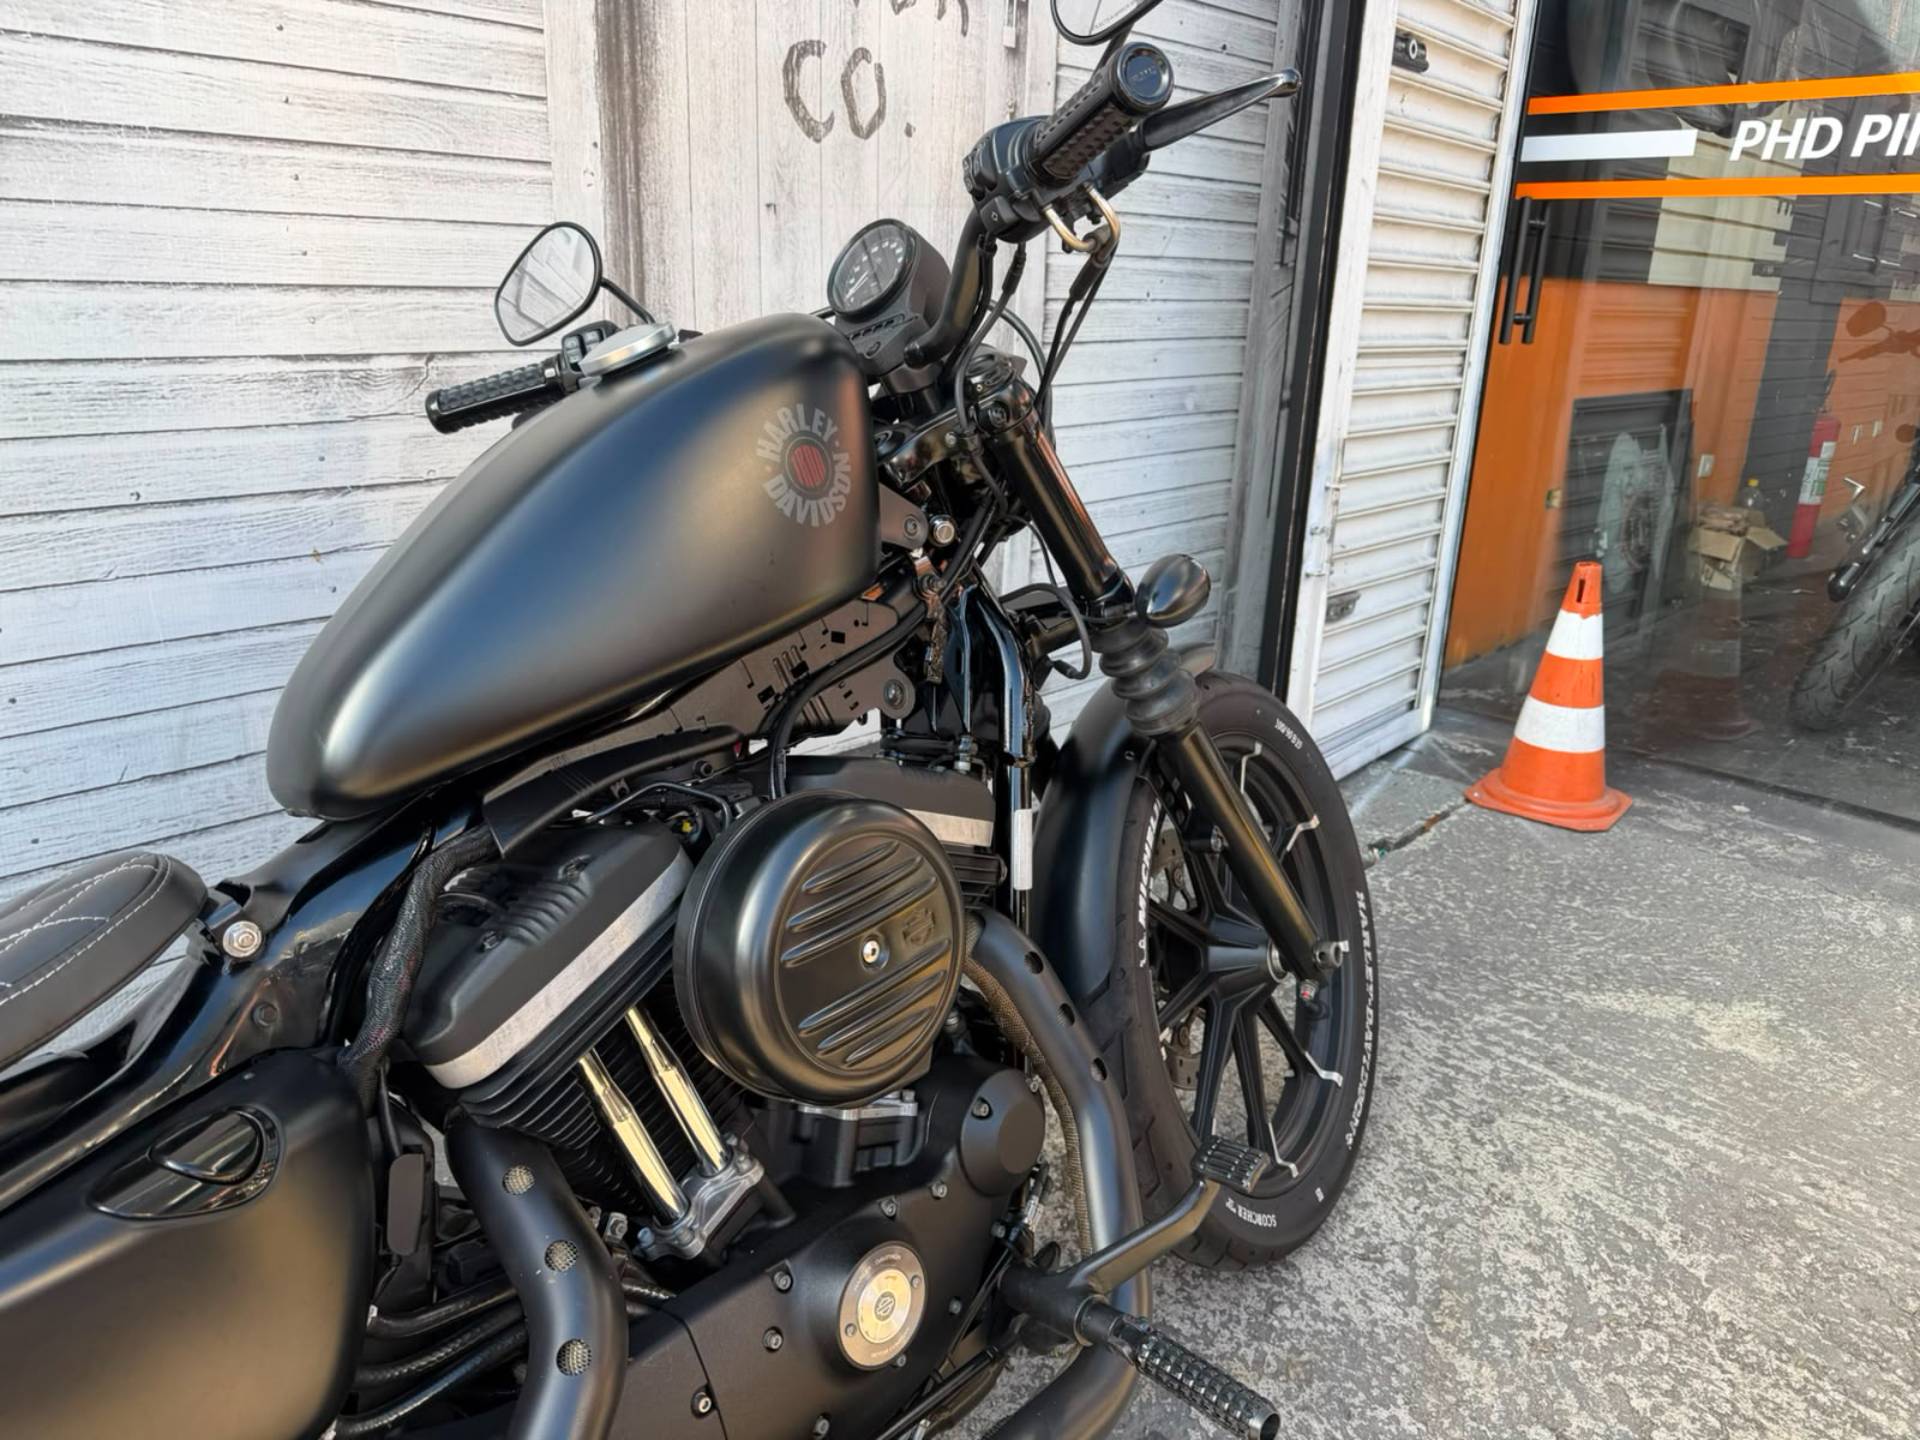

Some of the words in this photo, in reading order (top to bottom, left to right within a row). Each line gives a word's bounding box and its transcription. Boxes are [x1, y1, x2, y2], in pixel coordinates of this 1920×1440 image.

[782, 39, 916, 143] CO.
[1729, 116, 1843, 161] PHD
[756, 403, 839, 463] HARLEY
[762, 452, 852, 527] DAVIDSON
[1138, 798, 1161, 929] MICHELI
